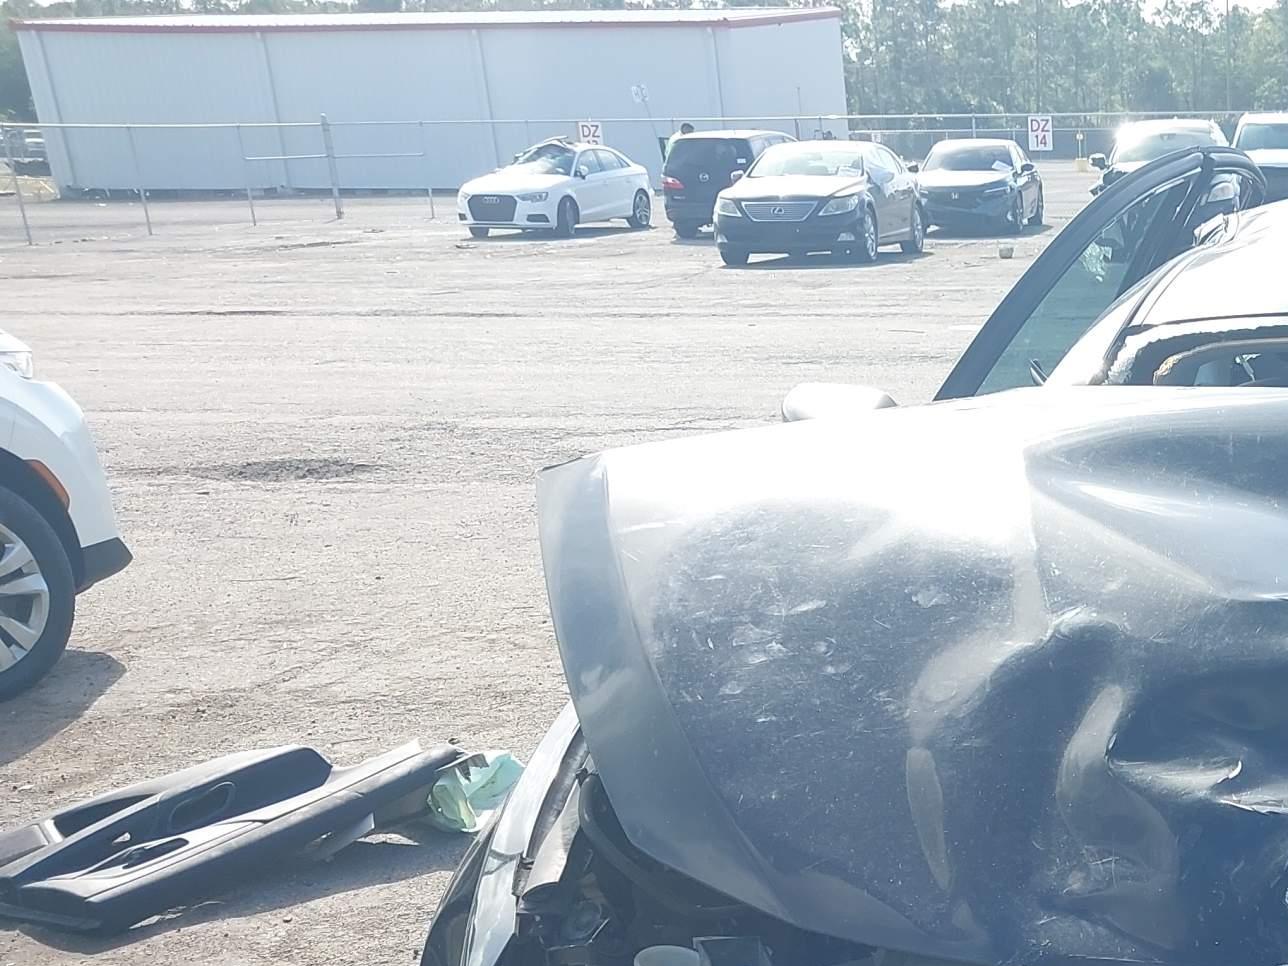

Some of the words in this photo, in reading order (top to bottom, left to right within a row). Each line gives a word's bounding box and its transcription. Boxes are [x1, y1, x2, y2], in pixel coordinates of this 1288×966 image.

[581, 124, 600, 138] DZ
[1031, 119, 1050, 132] DZ
[1035, 134, 1047, 148] 14
